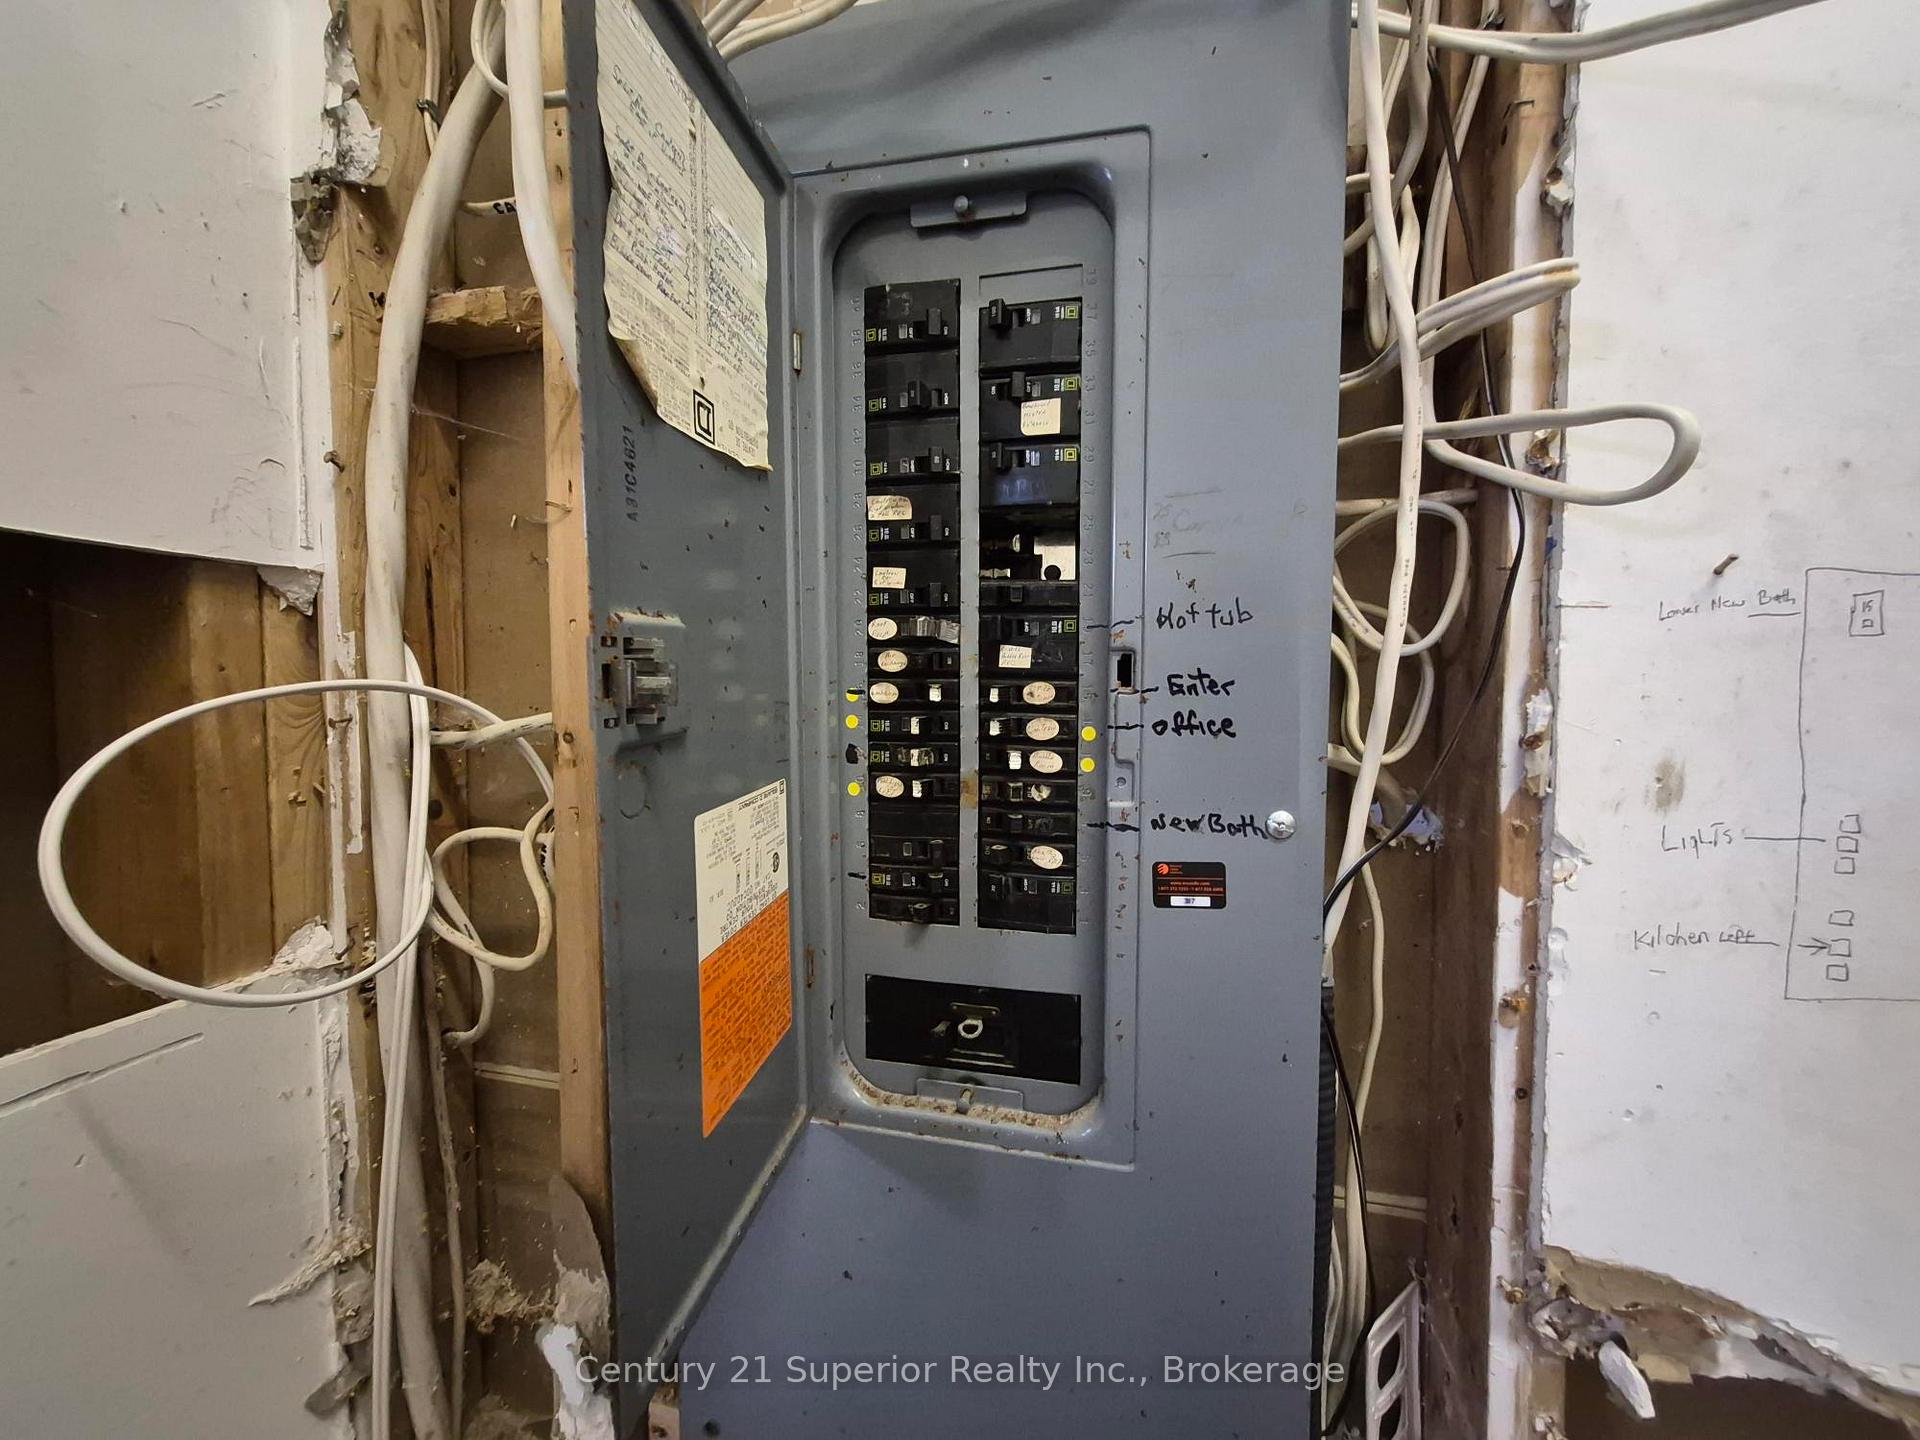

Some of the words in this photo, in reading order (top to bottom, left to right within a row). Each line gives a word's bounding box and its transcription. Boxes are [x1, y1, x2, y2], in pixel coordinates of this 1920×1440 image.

[1156, 602, 1200, 629] Hot
[1205, 597, 1253, 629] tub
[1167, 667, 1235, 696] Enter
